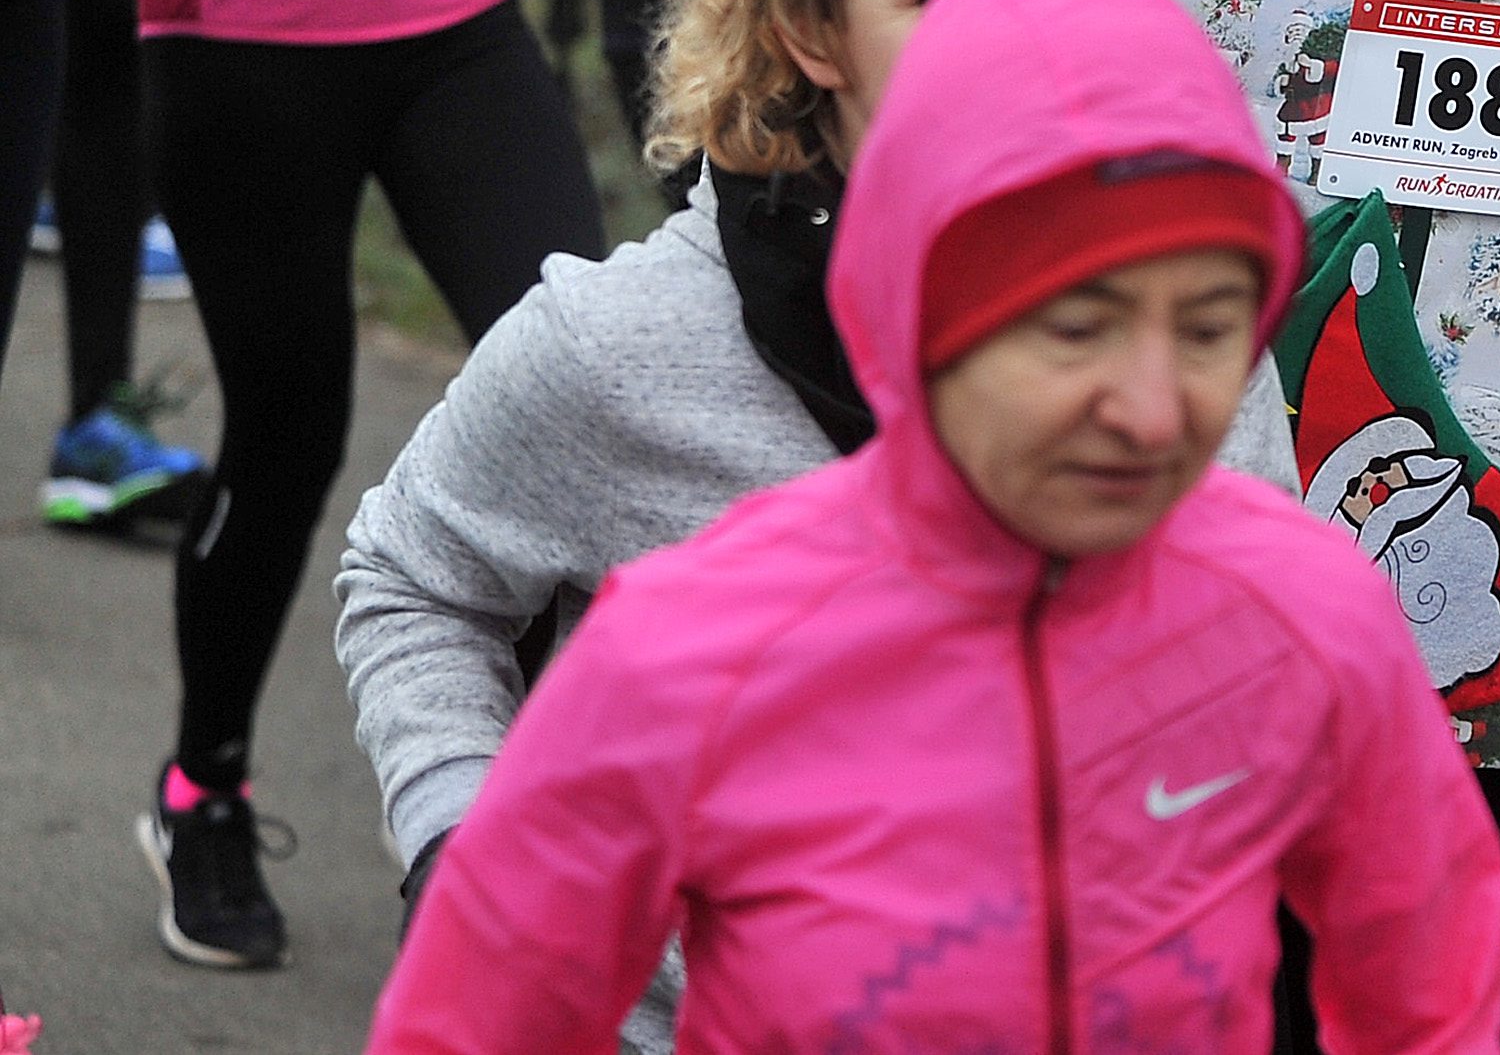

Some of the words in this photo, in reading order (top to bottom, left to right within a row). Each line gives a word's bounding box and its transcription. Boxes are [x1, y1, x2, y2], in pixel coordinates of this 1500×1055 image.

[1351, 131, 1410, 149] ADVENT
[1412, 139, 1447, 157] RUN,
[1450, 143, 1498, 160] Zagreb
[1396, 175, 1433, 193] RUN
